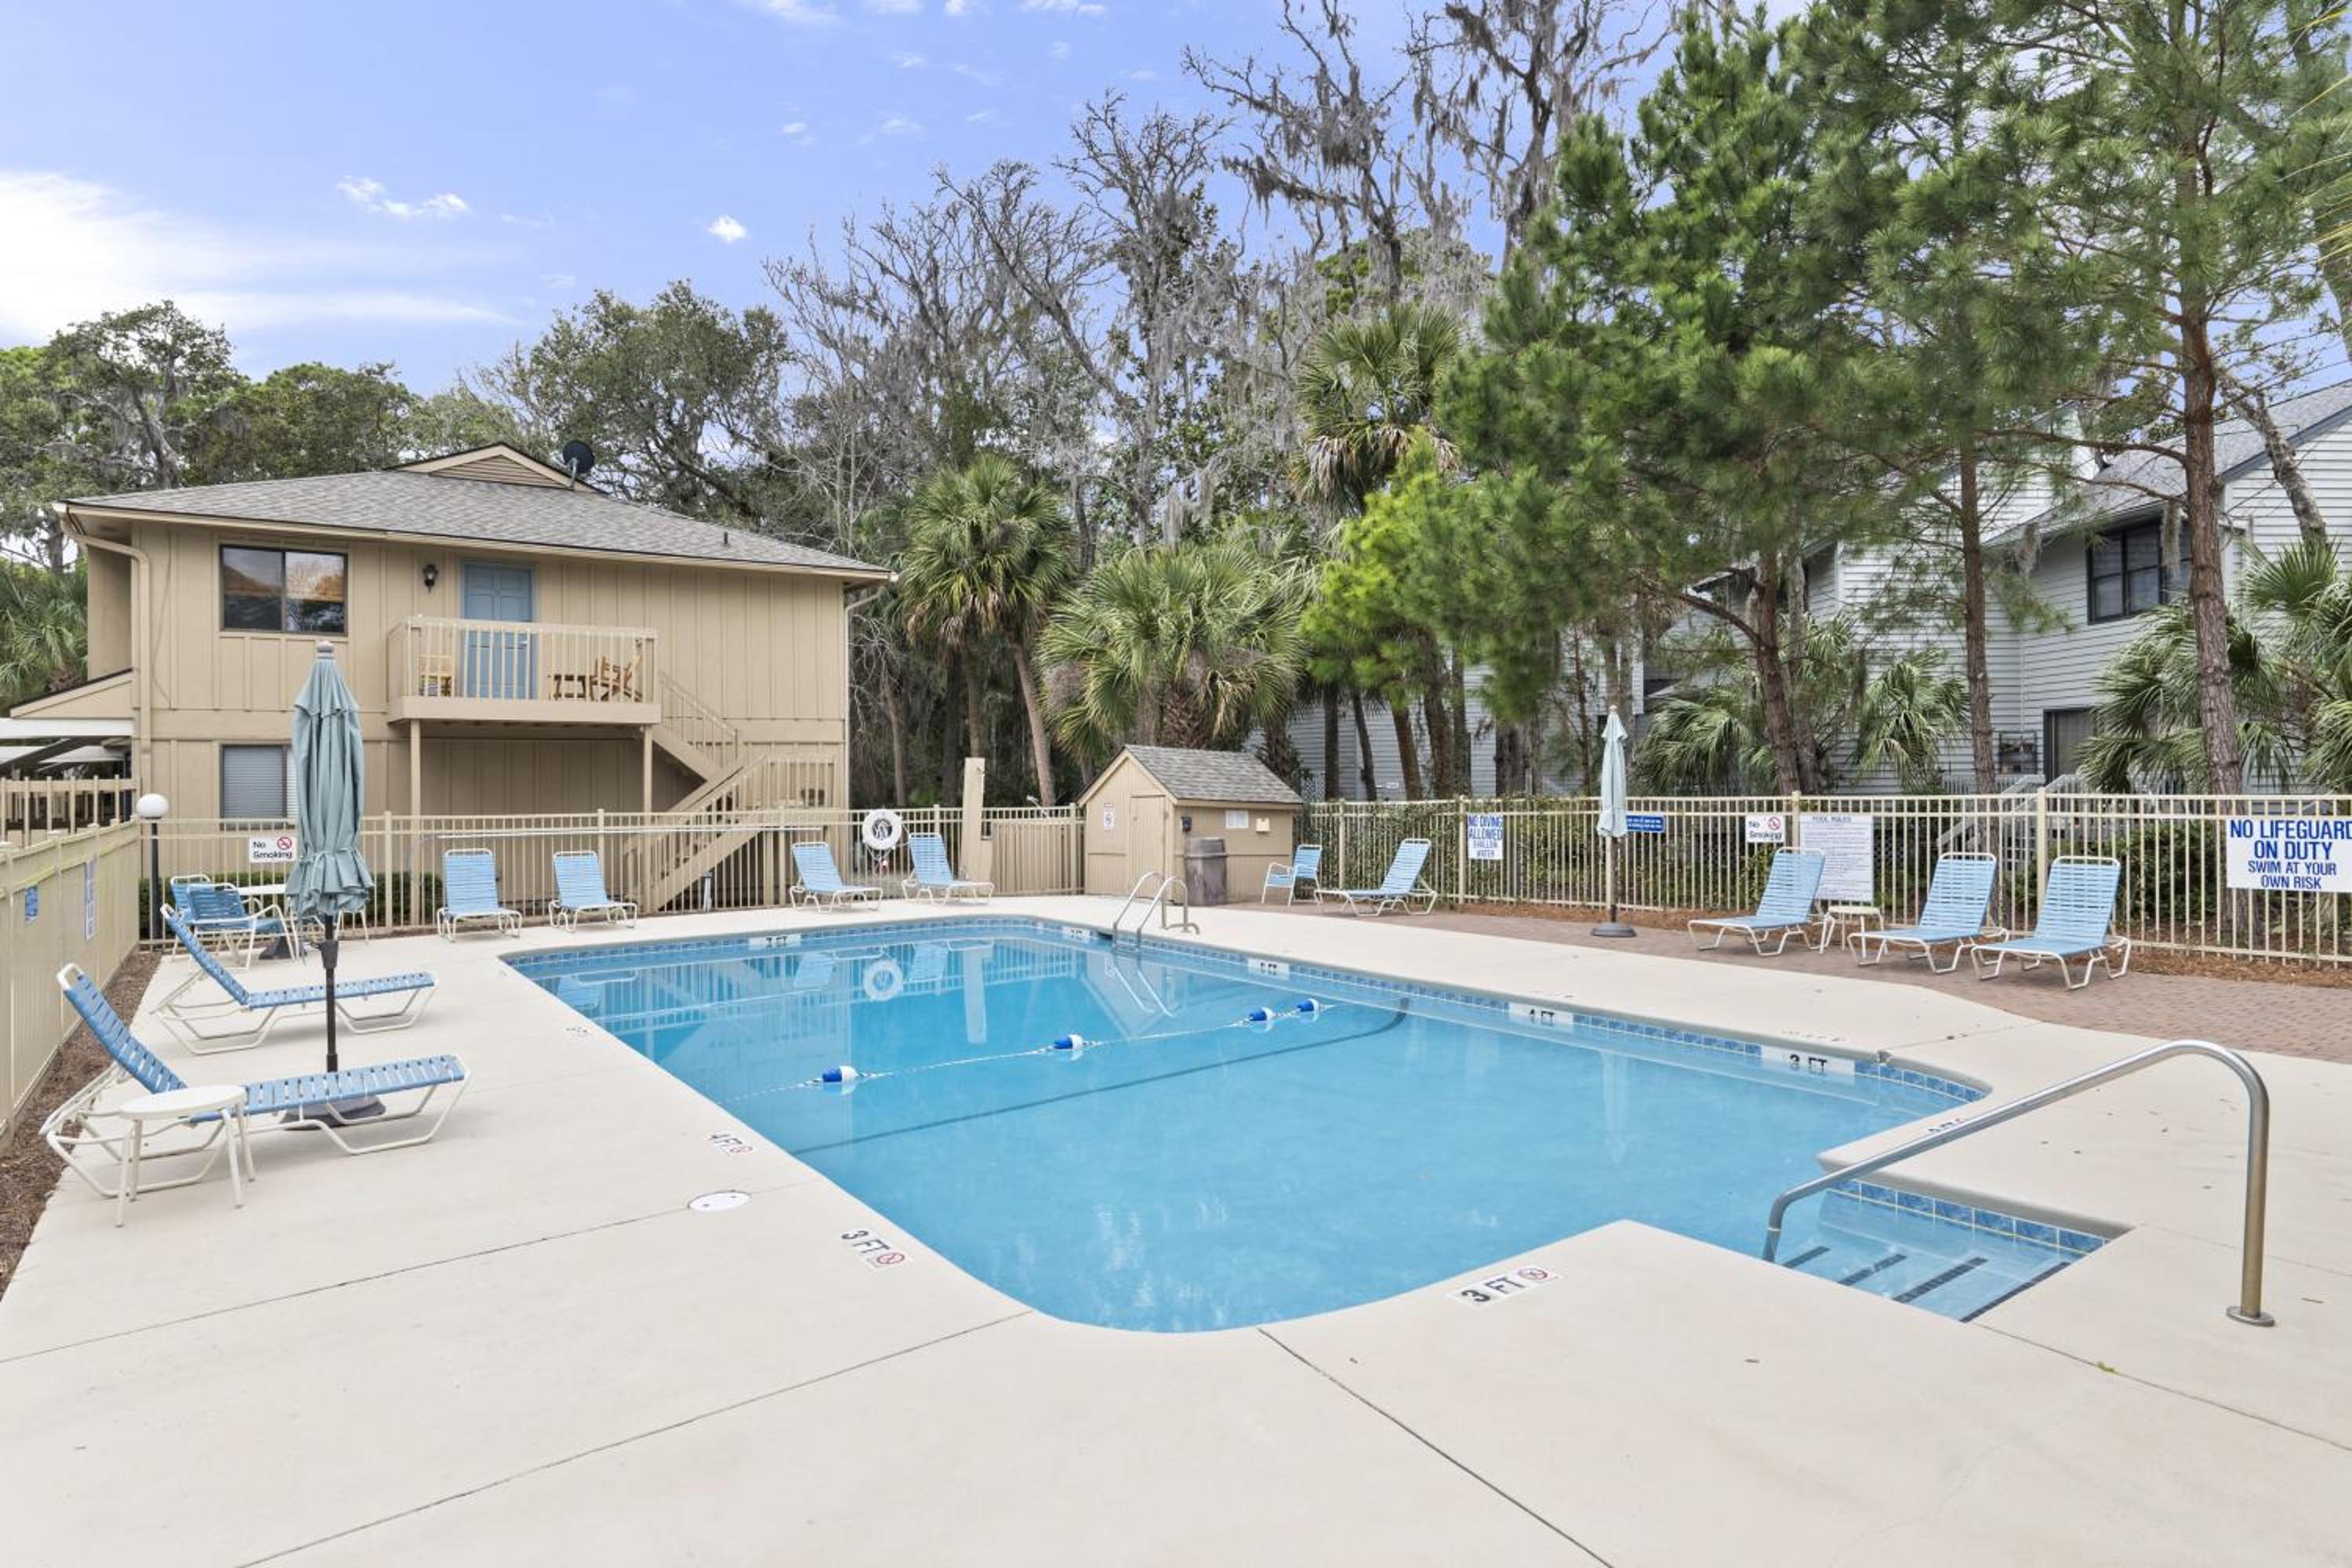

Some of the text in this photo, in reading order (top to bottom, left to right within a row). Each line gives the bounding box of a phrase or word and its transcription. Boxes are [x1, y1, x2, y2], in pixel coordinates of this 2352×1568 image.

[1468, 815, 1502, 827] NO DIVING
[1468, 827, 1503, 840] ALLOWED
[1749, 830, 1782, 840] Smoking
[2230, 819, 2253, 838] NO
[252, 851, 292, 859] Smoking
[1476, 849, 1494, 858] WATER
[2254, 840, 2332, 860] ON DUTY
[2248, 860, 2337, 876] SWIM AT YOUR
[2261, 874, 2321, 889] OWN RISK
[714, 1137, 742, 1147] FT
[841, 1230, 891, 1254] 3 FT
[1461, 1277, 1526, 1302] 3 FT
